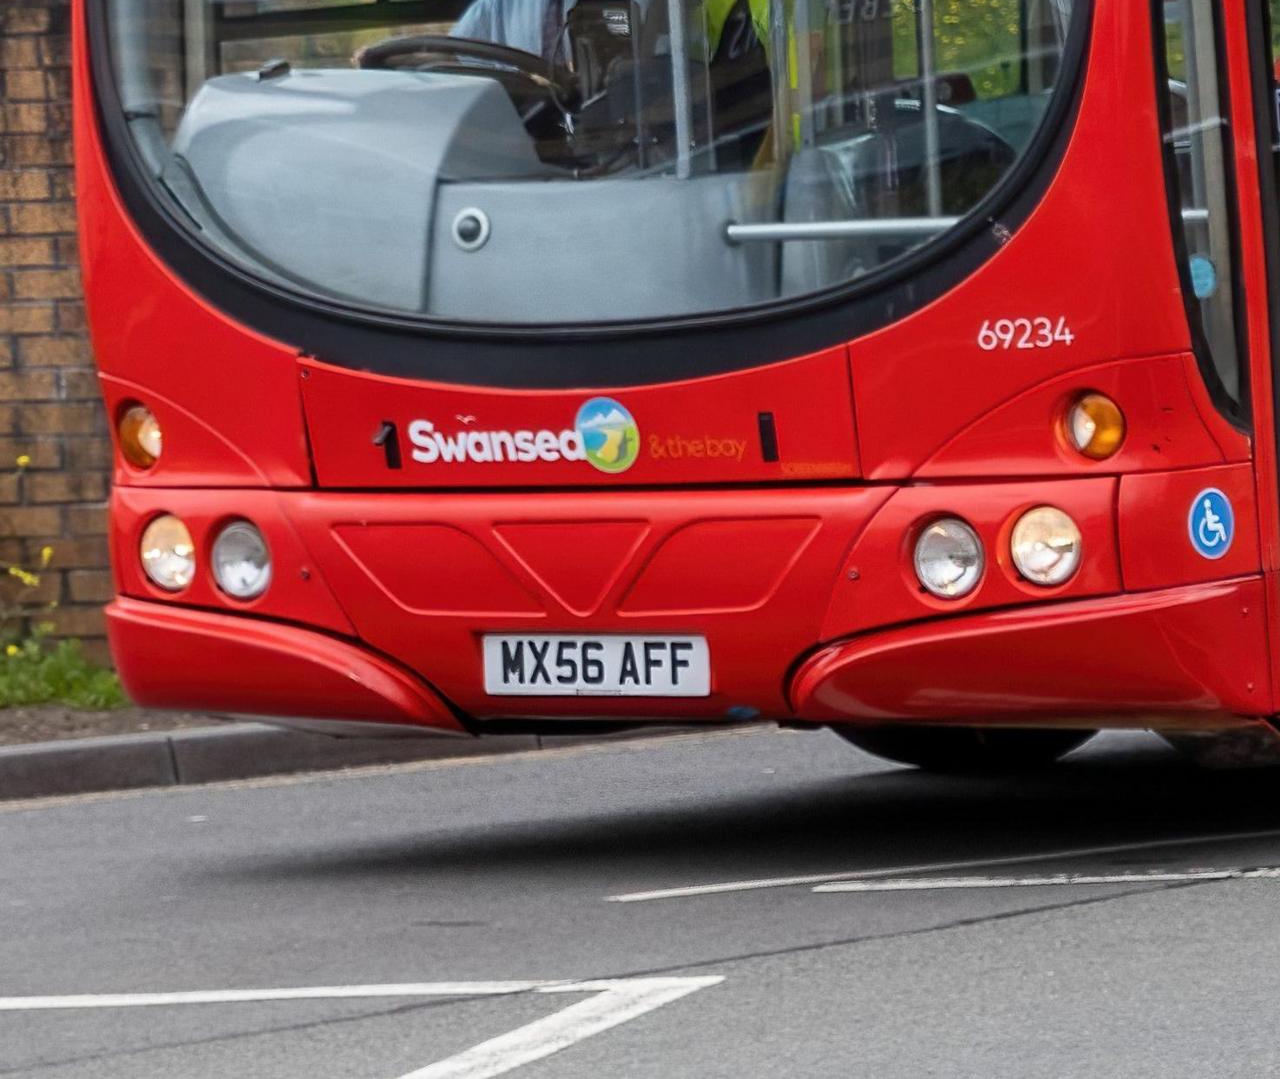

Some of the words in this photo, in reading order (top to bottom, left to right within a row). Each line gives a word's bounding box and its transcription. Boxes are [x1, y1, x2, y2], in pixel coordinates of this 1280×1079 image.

[977, 316, 1074, 350] 69234
[408, 418, 587, 463] Swansea
[501, 640, 605, 685] MX56
[619, 641, 694, 685] AFF
